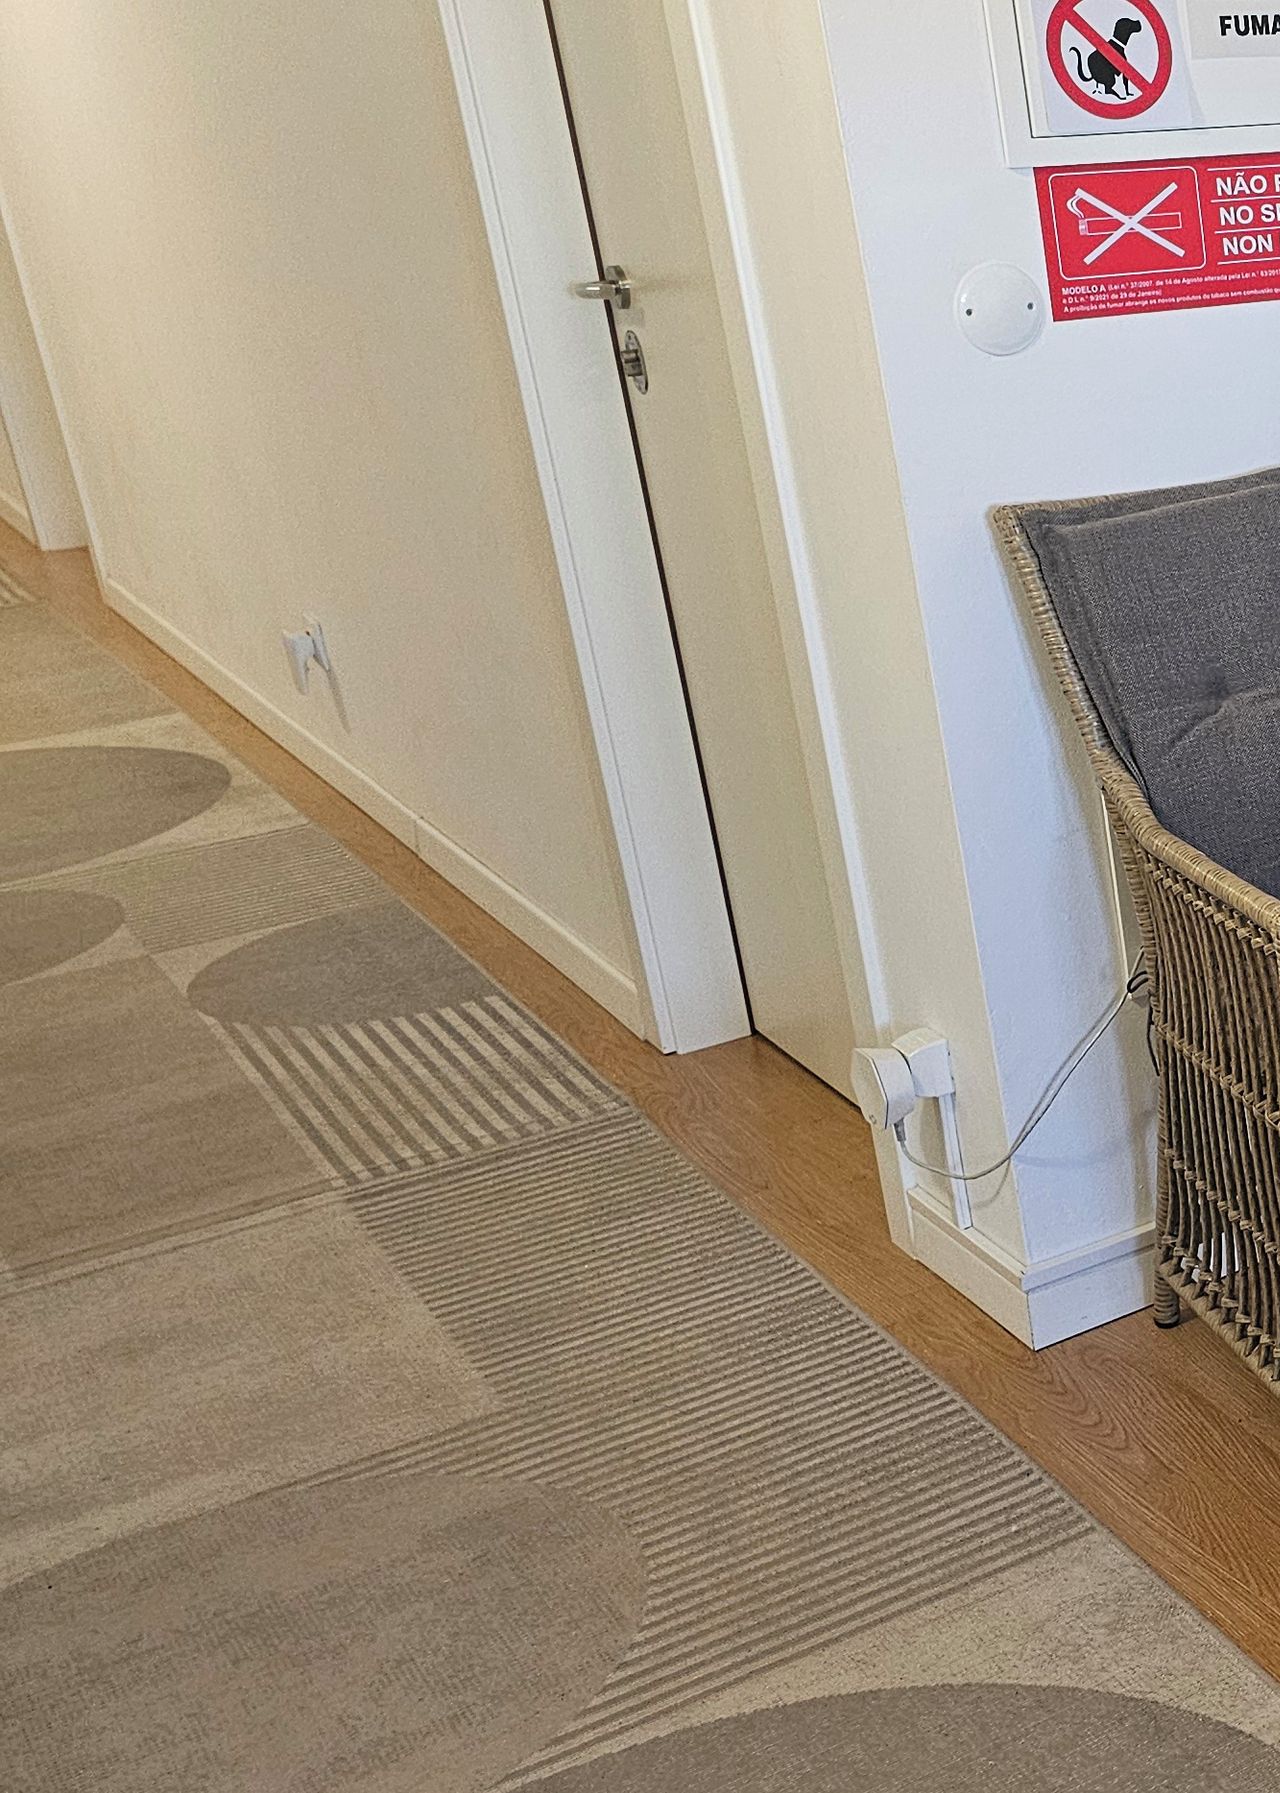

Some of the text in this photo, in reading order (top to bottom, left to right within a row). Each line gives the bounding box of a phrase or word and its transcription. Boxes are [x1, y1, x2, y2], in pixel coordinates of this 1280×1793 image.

[1214, 170, 1267, 196] NÃO
[1218, 204, 1254, 225] NO
[1221, 233, 1273, 256] NON
[1061, 284, 1098, 295] MODELO
